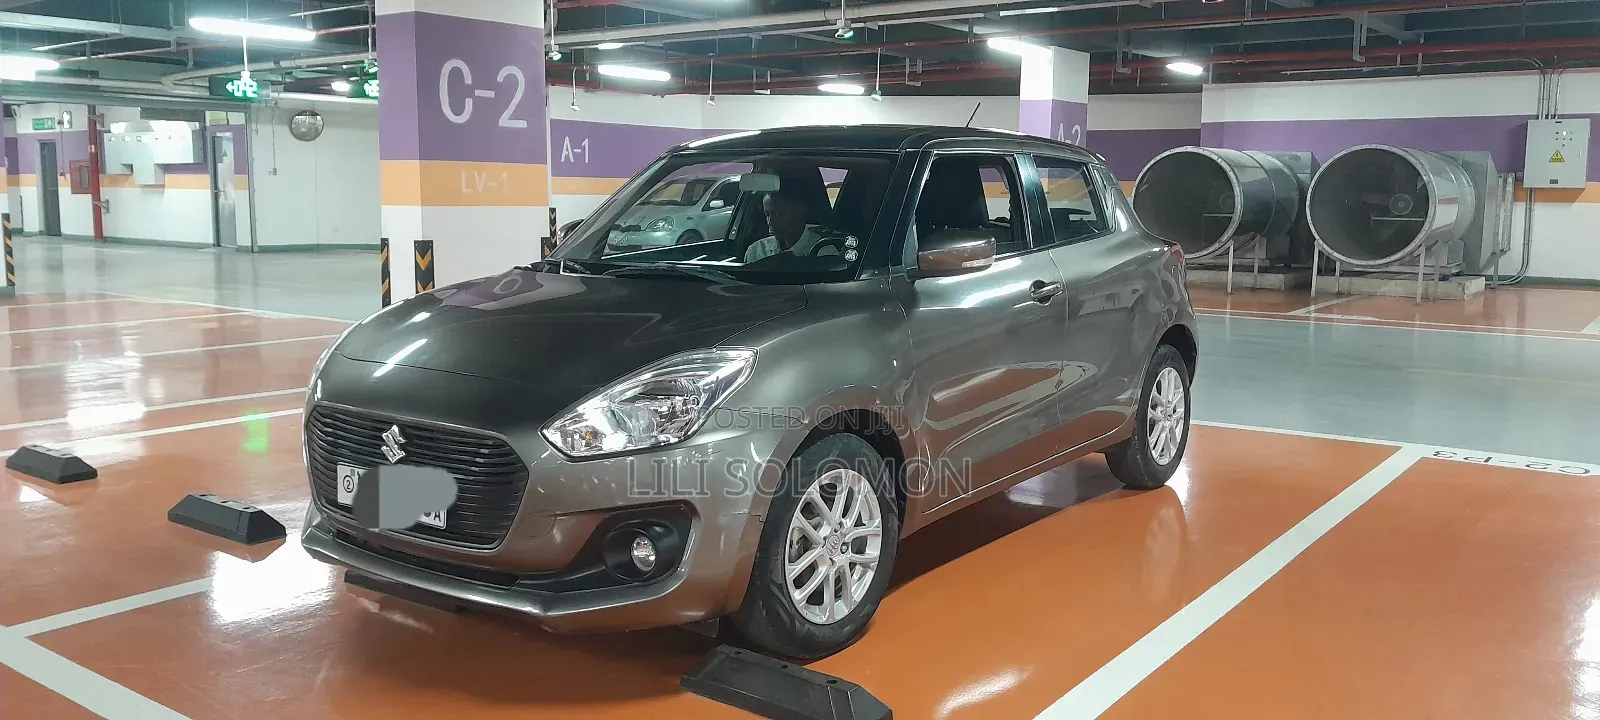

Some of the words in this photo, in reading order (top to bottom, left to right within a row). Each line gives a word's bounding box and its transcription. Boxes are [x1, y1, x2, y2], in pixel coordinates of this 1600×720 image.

[439, 58, 527, 128] C-2
[560, 136, 589, 163] A-1
[461, 170, 509, 194] LV-1
[1432, 450, 1591, 474] C2-P3
